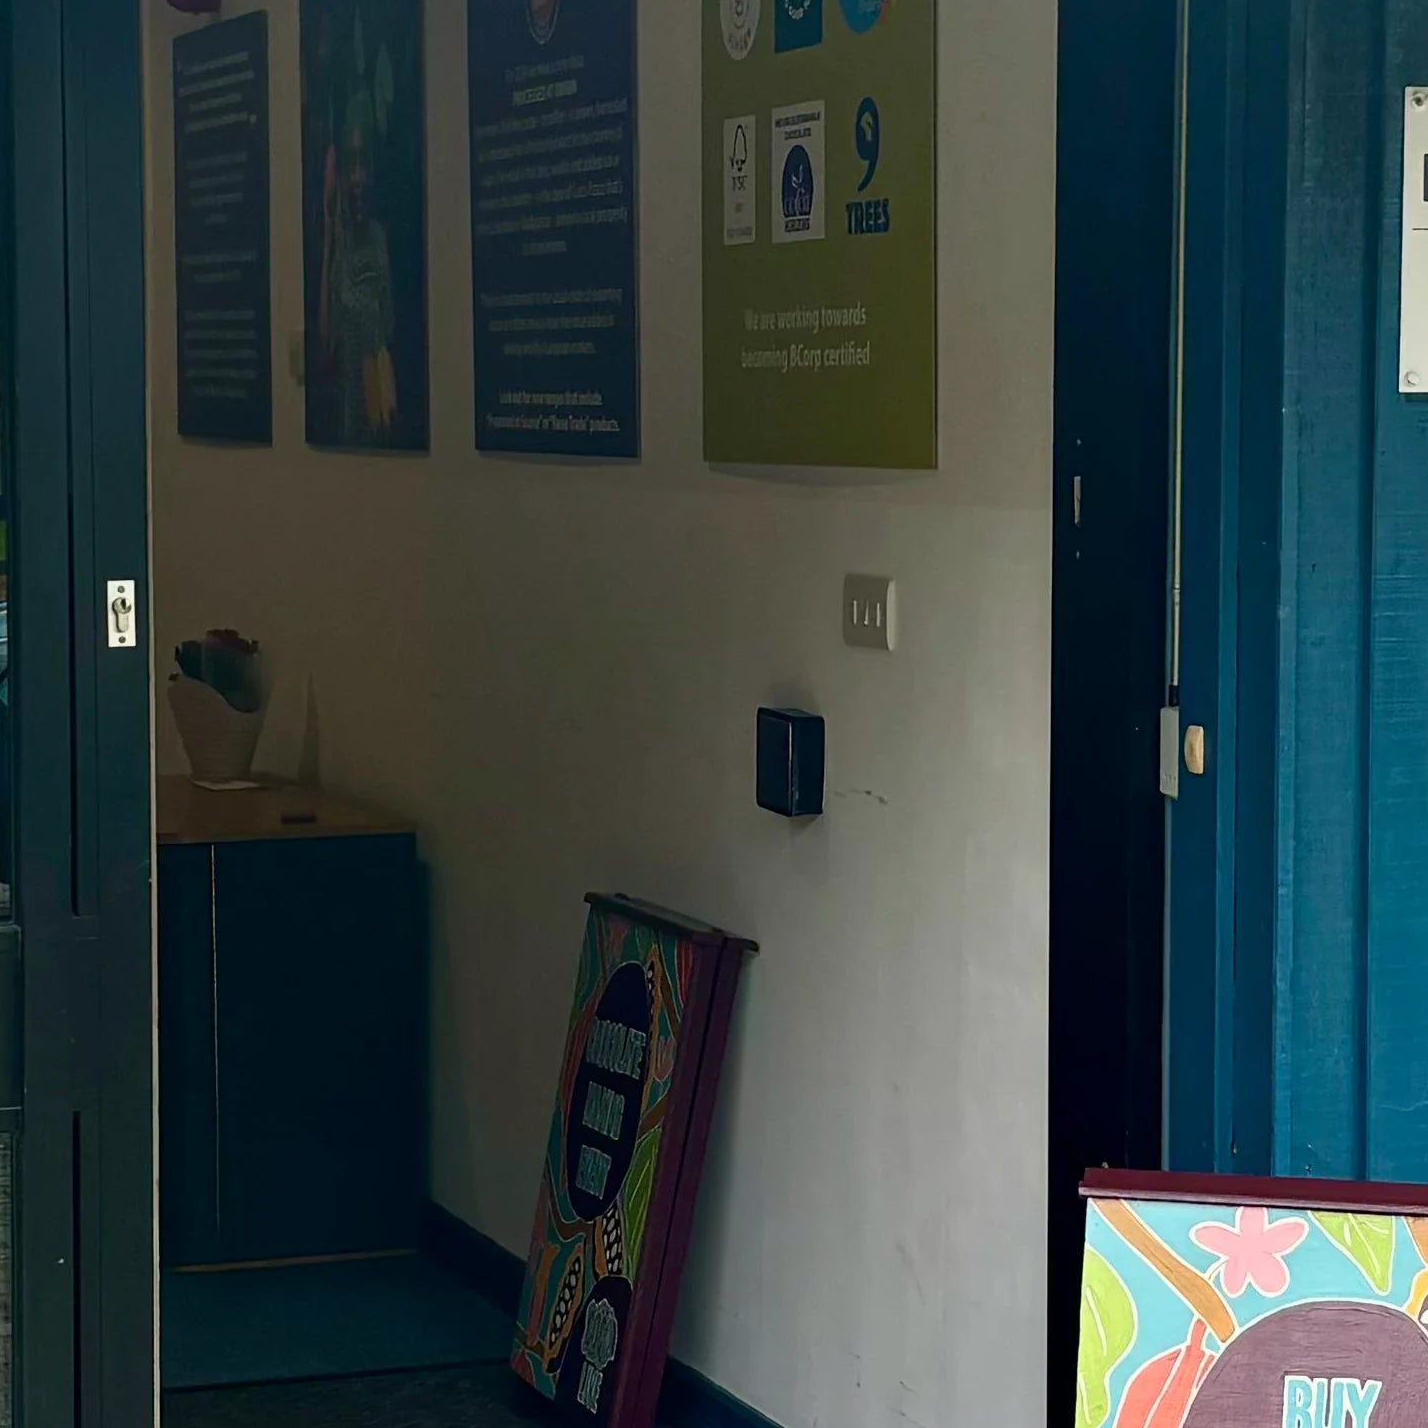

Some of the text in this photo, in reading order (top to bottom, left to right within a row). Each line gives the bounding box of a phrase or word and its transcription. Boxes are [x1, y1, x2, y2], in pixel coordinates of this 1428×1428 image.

[845, 198, 890, 235] TREES
[744, 301, 866, 334] We are working towards
[741, 340, 870, 373] becoming BCorp certified
